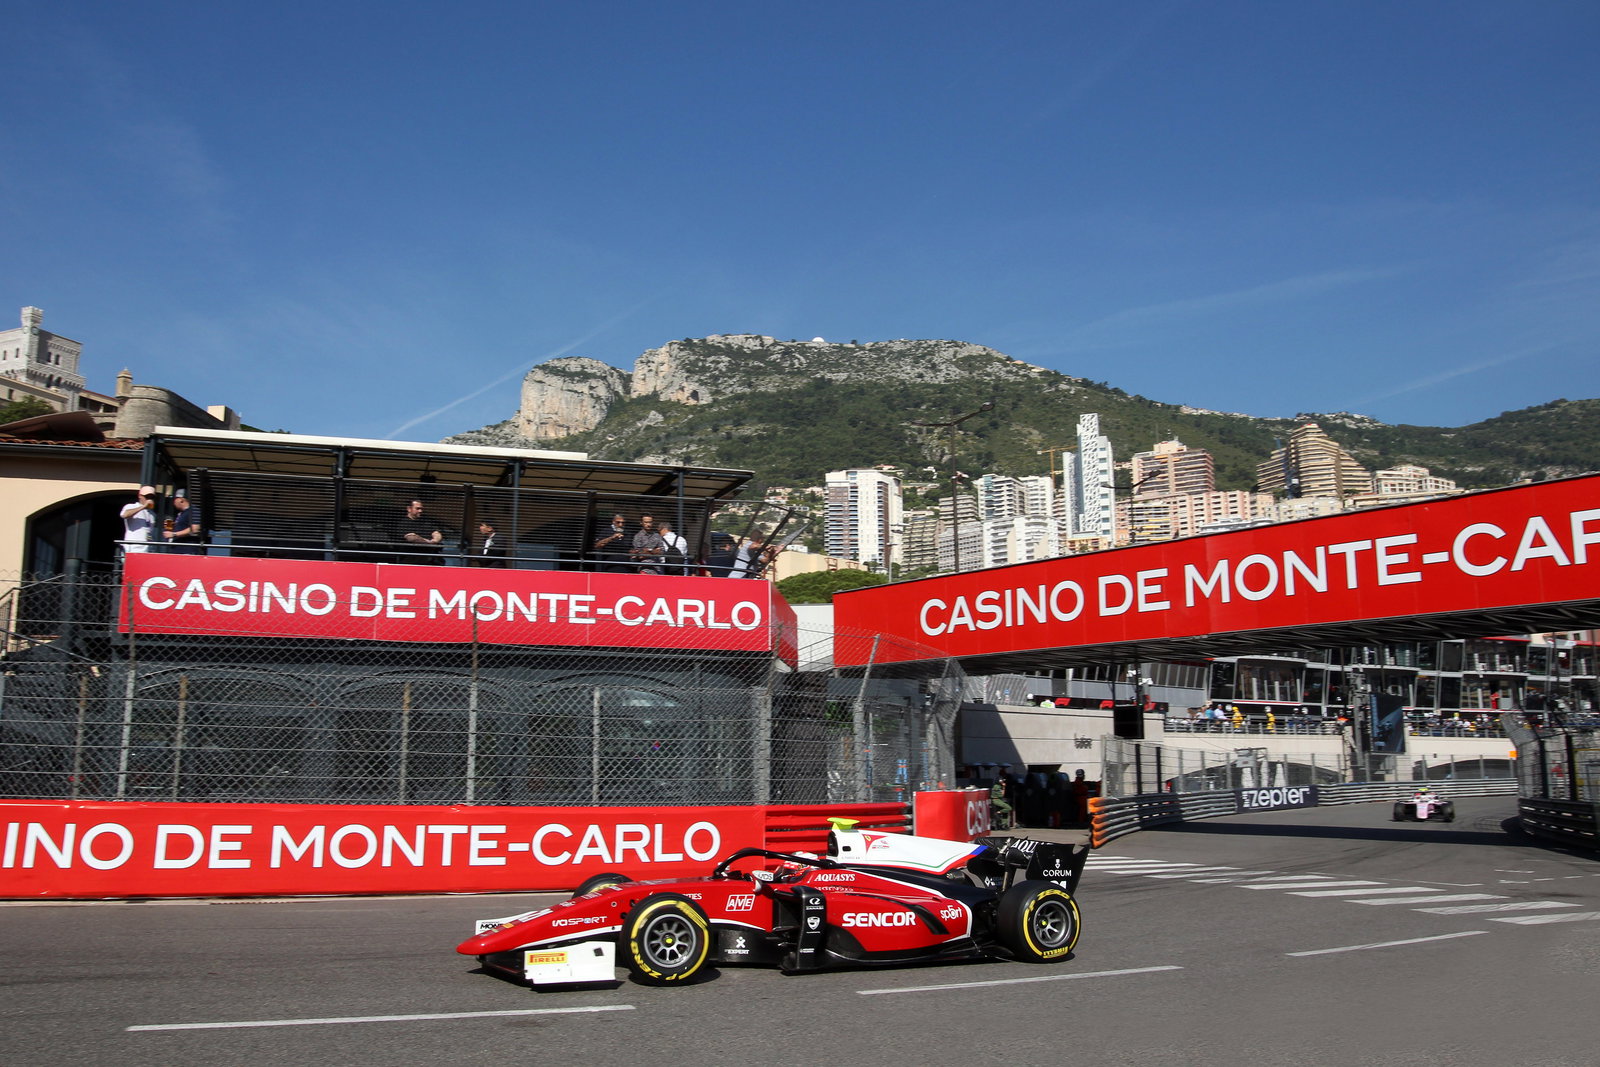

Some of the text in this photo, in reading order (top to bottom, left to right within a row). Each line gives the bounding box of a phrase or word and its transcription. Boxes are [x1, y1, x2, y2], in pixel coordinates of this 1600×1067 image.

[138, 576, 762, 632] CASINO DE MONTE-CARLO
[920, 581, 1085, 637] CASINO
[1098, 568, 1171, 617] DE
[1250, 788, 1310, 808] zepter
[2, 822, 721, 870] INO DE MONTE-CARLO
[814, 873, 856, 882] AQUASYS
[1042, 869, 1072, 877] CORUM
[727, 895, 754, 911] AVE
[841, 911, 917, 928] SENCOR
[529, 952, 566, 963] PIRELLI
